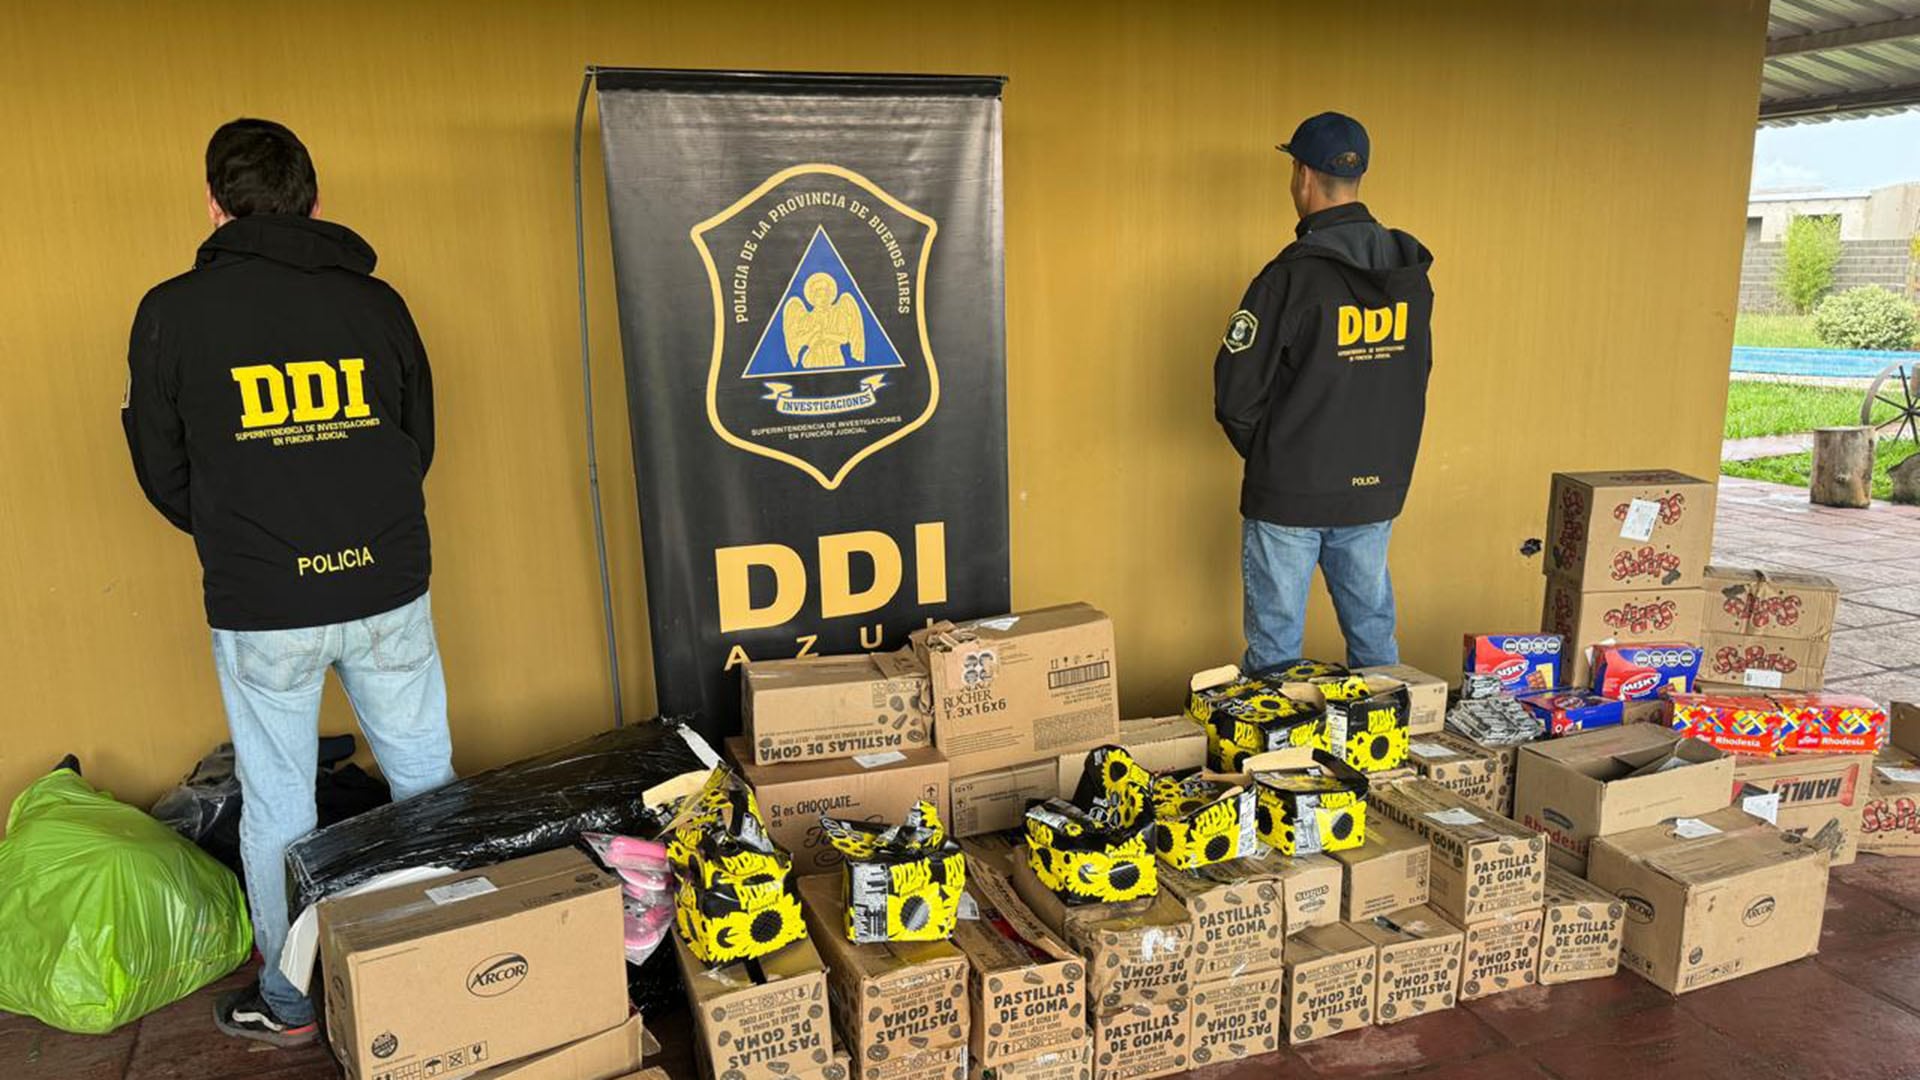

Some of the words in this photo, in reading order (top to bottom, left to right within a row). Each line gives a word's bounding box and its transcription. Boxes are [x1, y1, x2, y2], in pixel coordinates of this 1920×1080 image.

[733, 263, 749, 324] POLICIA
[741, 239, 758, 261] DE
[752, 220, 771, 240] LA
[767, 191, 847, 223] PROVINCIA
[849, 200, 870, 219] DE
[868, 215, 905, 268] BUENOS
[896, 271, 910, 315] AIRES
[1337, 301, 1408, 346] DDI
[231, 358, 371, 429] DDI
[782, 393, 873, 412] INVESTIGACIONES
[235, 426, 304, 442] SUPERINTENDENCIA
[305, 424, 316, 433] DE
[751, 423, 826, 437] SUPERINTENDENCIA
[826, 421, 838, 430] DE
[838, 415, 902, 428] INVESTIGACIONES
[788, 432, 800, 441] EN
[834, 426, 868, 437] JUDICIAL
[1351, 475, 1381, 487] POLICIA
[297, 546, 375, 576] POLICIA
[715, 522, 948, 634] DDI
[807, 743, 824, 756] DE
[828, 733, 903, 753] PASTILLAS
[1715, 735, 1761, 748] Rhodesia
[1821, 736, 1866, 746] Rhodesia
[760, 745, 801, 762] GOMA
[1440, 774, 1491, 790] ASTILLAS
[1367, 794, 1415, 831] ASTILLAS
[1433, 831, 1464, 859] GOMA
[1473, 852, 1538, 875] PASTILLAS
[889, 857, 932, 895] PIPAS
[1477, 871, 1493, 887] DE
[1497, 866, 1532, 883] GOMA
[1200, 902, 1272, 929] PASTILLAS
[1205, 926, 1222, 942] DE
[1227, 919, 1267, 938] GOMA
[1551, 920, 1617, 936] PASTILLAS
[1555, 935, 1571, 948] DE
[1574, 932, 1610, 946] GOMA
[1477, 949, 1512, 966] GOMA
[1514, 945, 1530, 959] DE
[470, 956, 527, 990] ARCOR
[1120, 963, 1164, 980] GOMA
[1170, 958, 1185, 973] DE
[1433, 969, 1448, 982] DE
[1471, 957, 1533, 981] PASTILLAS
[1112, 969, 1188, 994] PASTILLAS
[1349, 984, 1364, 998] DE
[1393, 972, 1430, 989] GOMA
[994, 981, 1076, 1010] PASTILLAS
[1307, 989, 1345, 1009] GOMA
[1387, 980, 1452, 1004] PASTILLAS
[935, 997, 952, 1013] DE
[1000, 1007, 1019, 1024] DE
[1024, 997, 1069, 1018] GOMA
[1302, 995, 1368, 1024] PASTILLAS
[875, 1009, 959, 1044] PASTILLAS
[883, 1004, 929, 1028] GOMA
[1104, 1012, 1180, 1041] PASTILLAS
[1207, 1013, 1246, 1033] GOMA
[1250, 1009, 1267, 1023] DE
[791, 1018, 813, 1036] DE
[1201, 1021, 1272, 1047] PASTILLAS
[733, 1027, 785, 1052] GOMA
[1110, 1037, 1127, 1054] DE
[1132, 1028, 1174, 1048] GOMA
[728, 1032, 820, 1069] PASTILLAS
